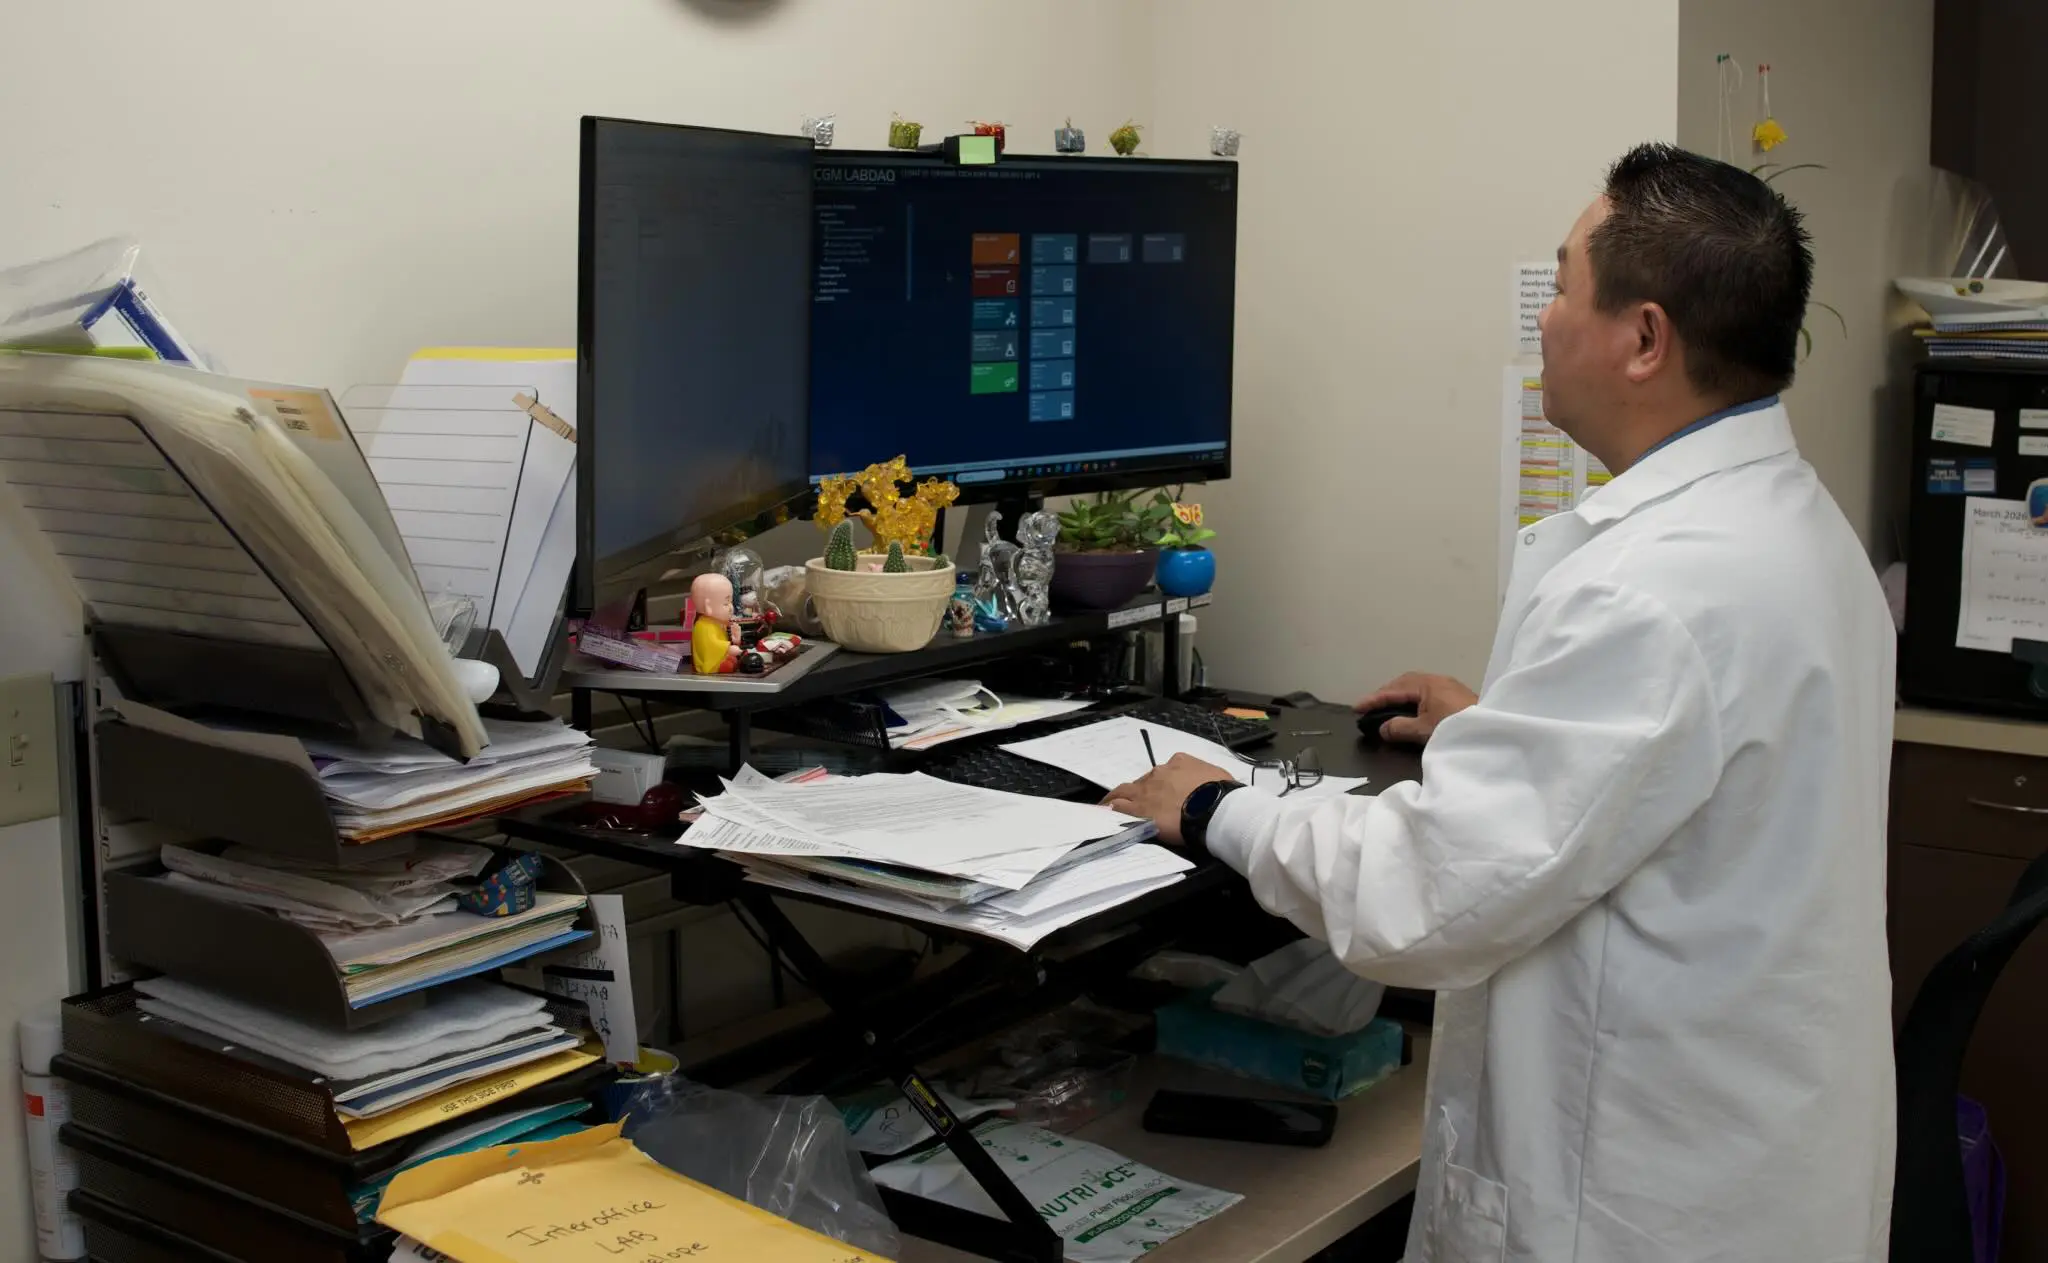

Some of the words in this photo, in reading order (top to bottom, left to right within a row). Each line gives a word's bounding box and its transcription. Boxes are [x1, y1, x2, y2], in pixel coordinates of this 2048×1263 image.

[814, 168, 844, 181] CGM
[844, 168, 896, 182] LABDAQ
[1520, 268, 1548, 276] Mitchell
[1520, 280, 1546, 288] Jocelyn
[1973, 508, 2001, 519] March
[2004, 510, 2028, 521] 2026
[440, 1102, 460, 1113] USE
[458, 1095, 478, 1106] THIS
[475, 1087, 497, 1099] SIDE
[495, 1079, 519, 1092] FIRST
[1088, 1202, 1116, 1219] PLANT
[594, 1229, 658, 1254] LAB
